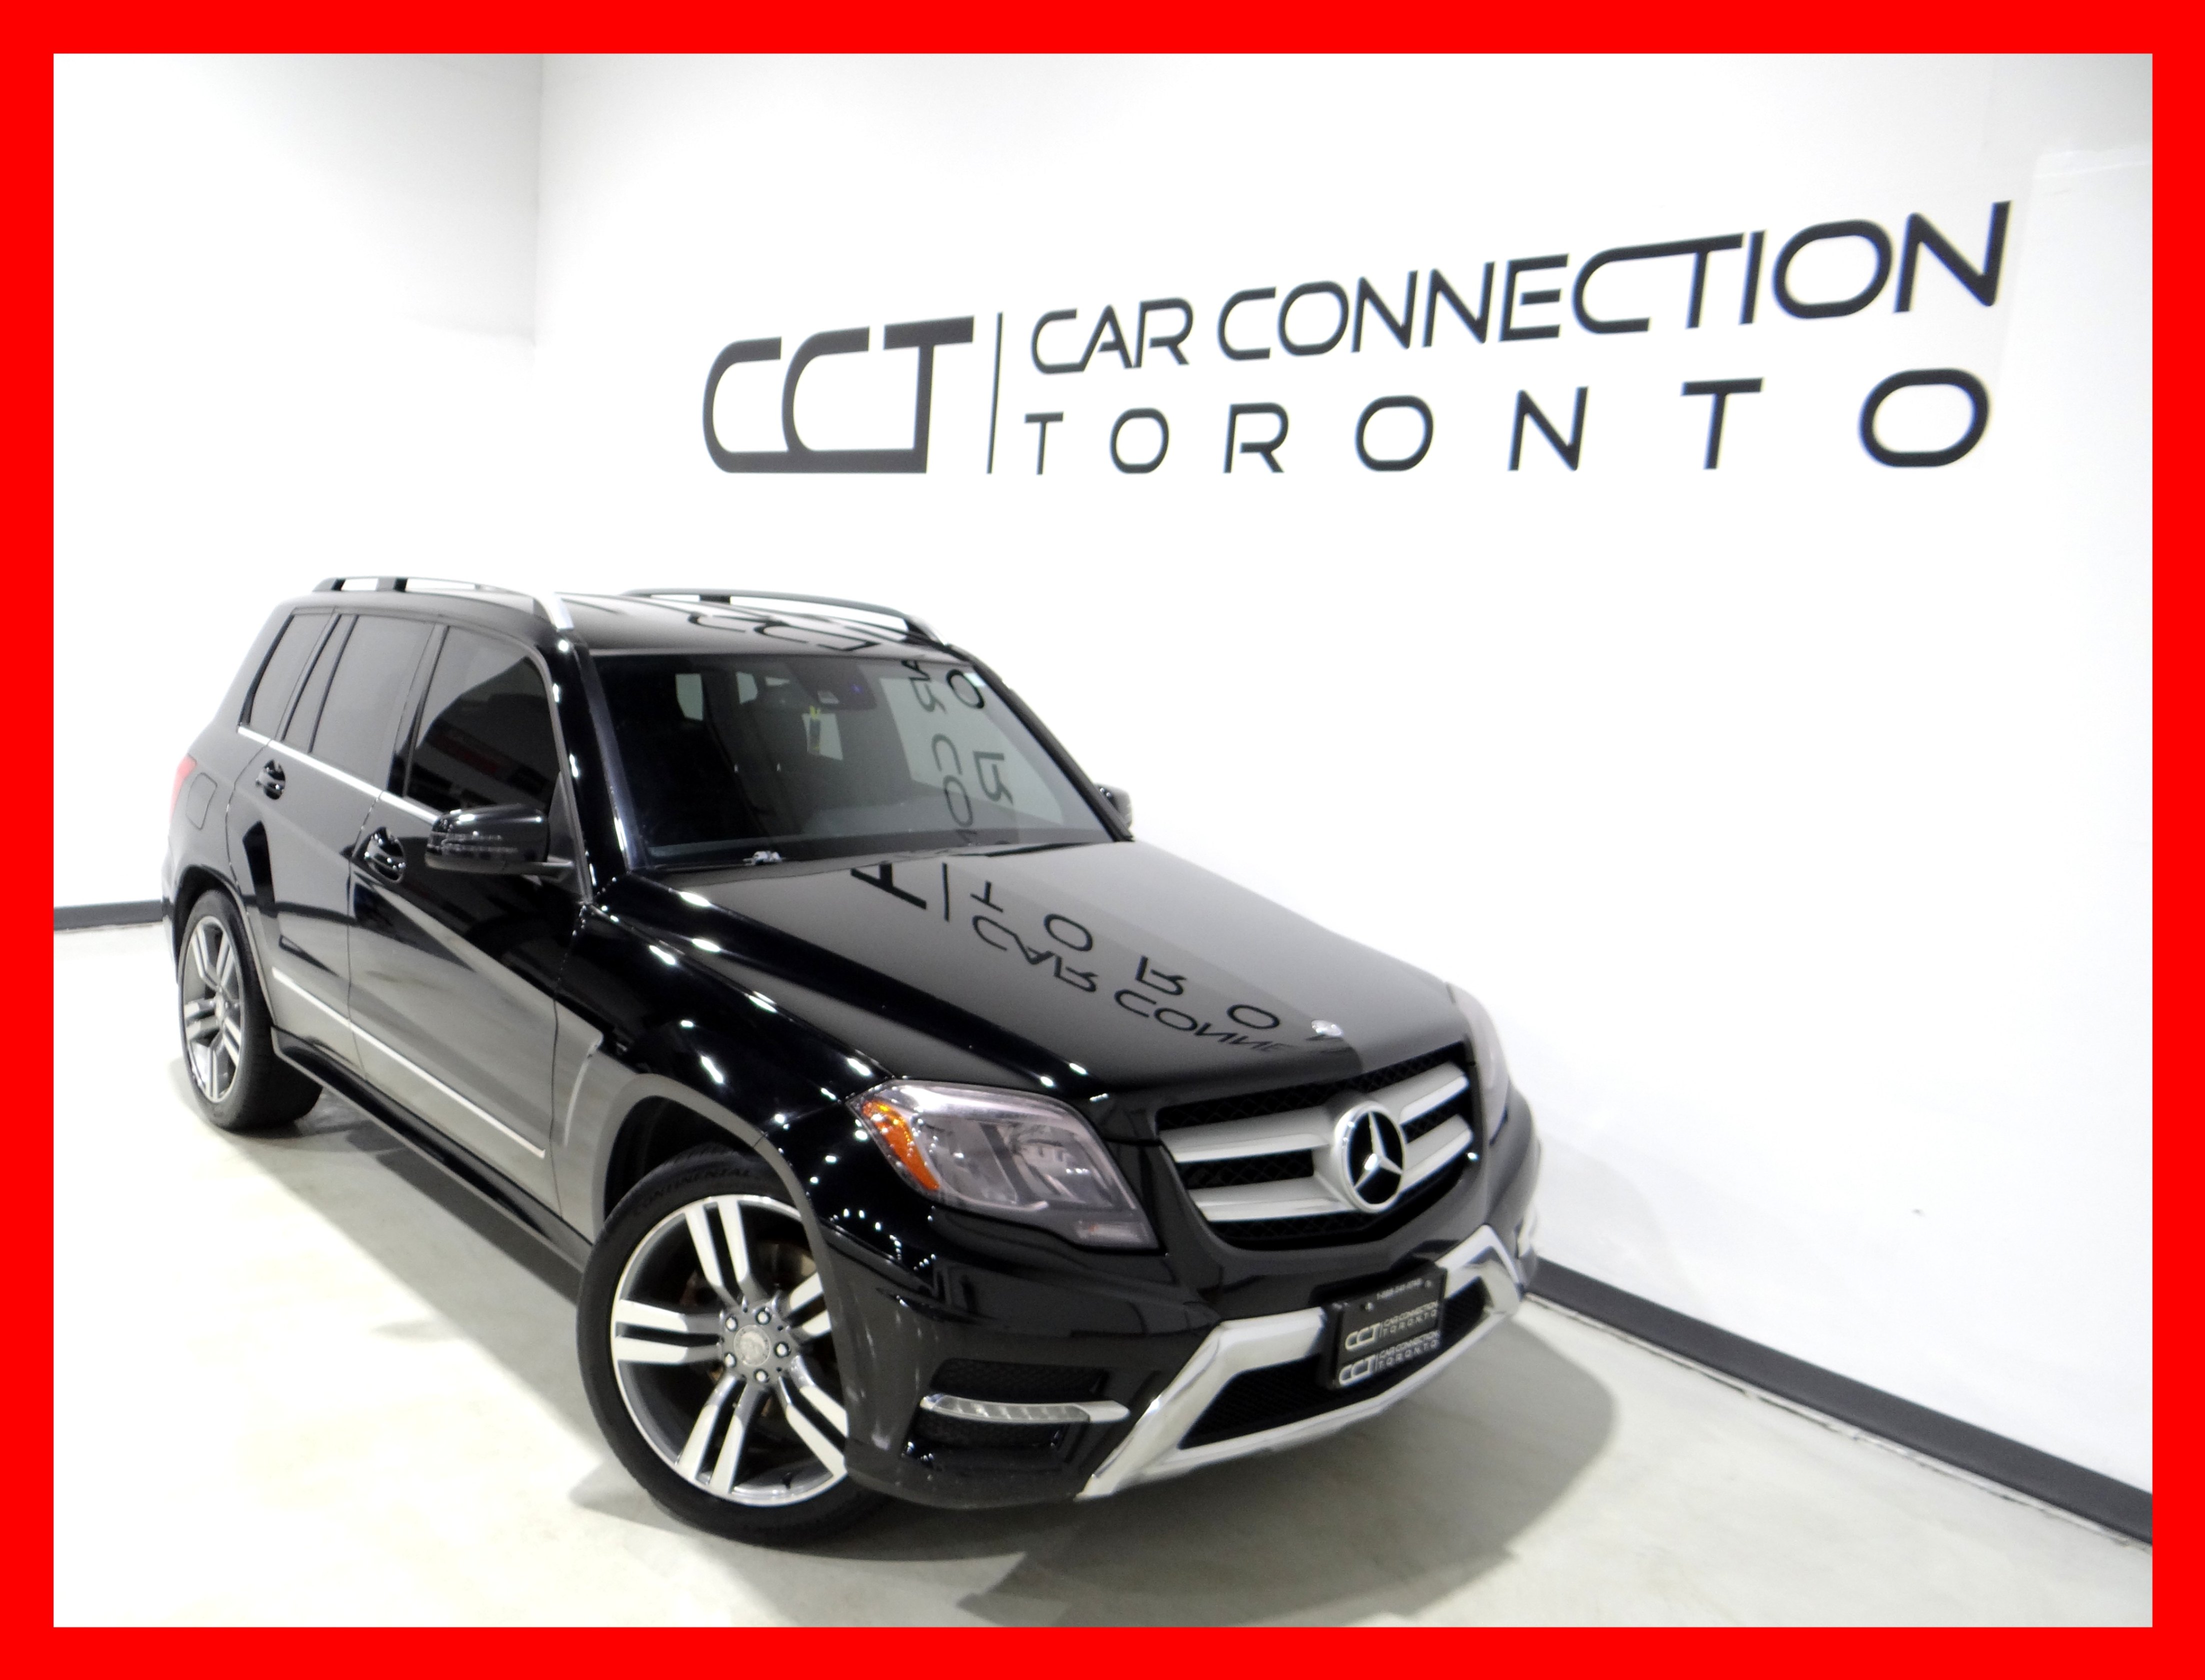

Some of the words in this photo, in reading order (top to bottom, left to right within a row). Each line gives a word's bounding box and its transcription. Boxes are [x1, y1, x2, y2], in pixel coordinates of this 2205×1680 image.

[1031, 297, 1194, 375] CAR
[1218, 200, 2011, 361] CONNECTION
[703, 315, 974, 474] CCT
[1025, 368, 1990, 474] TORONTO
[1382, 1309, 1438, 1338] TORONTO
[1383, 1315, 1400, 1327] CAR
[1400, 1300, 1438, 1320] CONNECTION
[1344, 1322, 1381, 1351] CCT
[1379, 1346, 1396, 1359] CAR
[1396, 1330, 1441, 1351] CONNECTION
[1378, 1339, 1440, 1370] TORONTO
[1338, 1354, 1376, 1387] CCT
